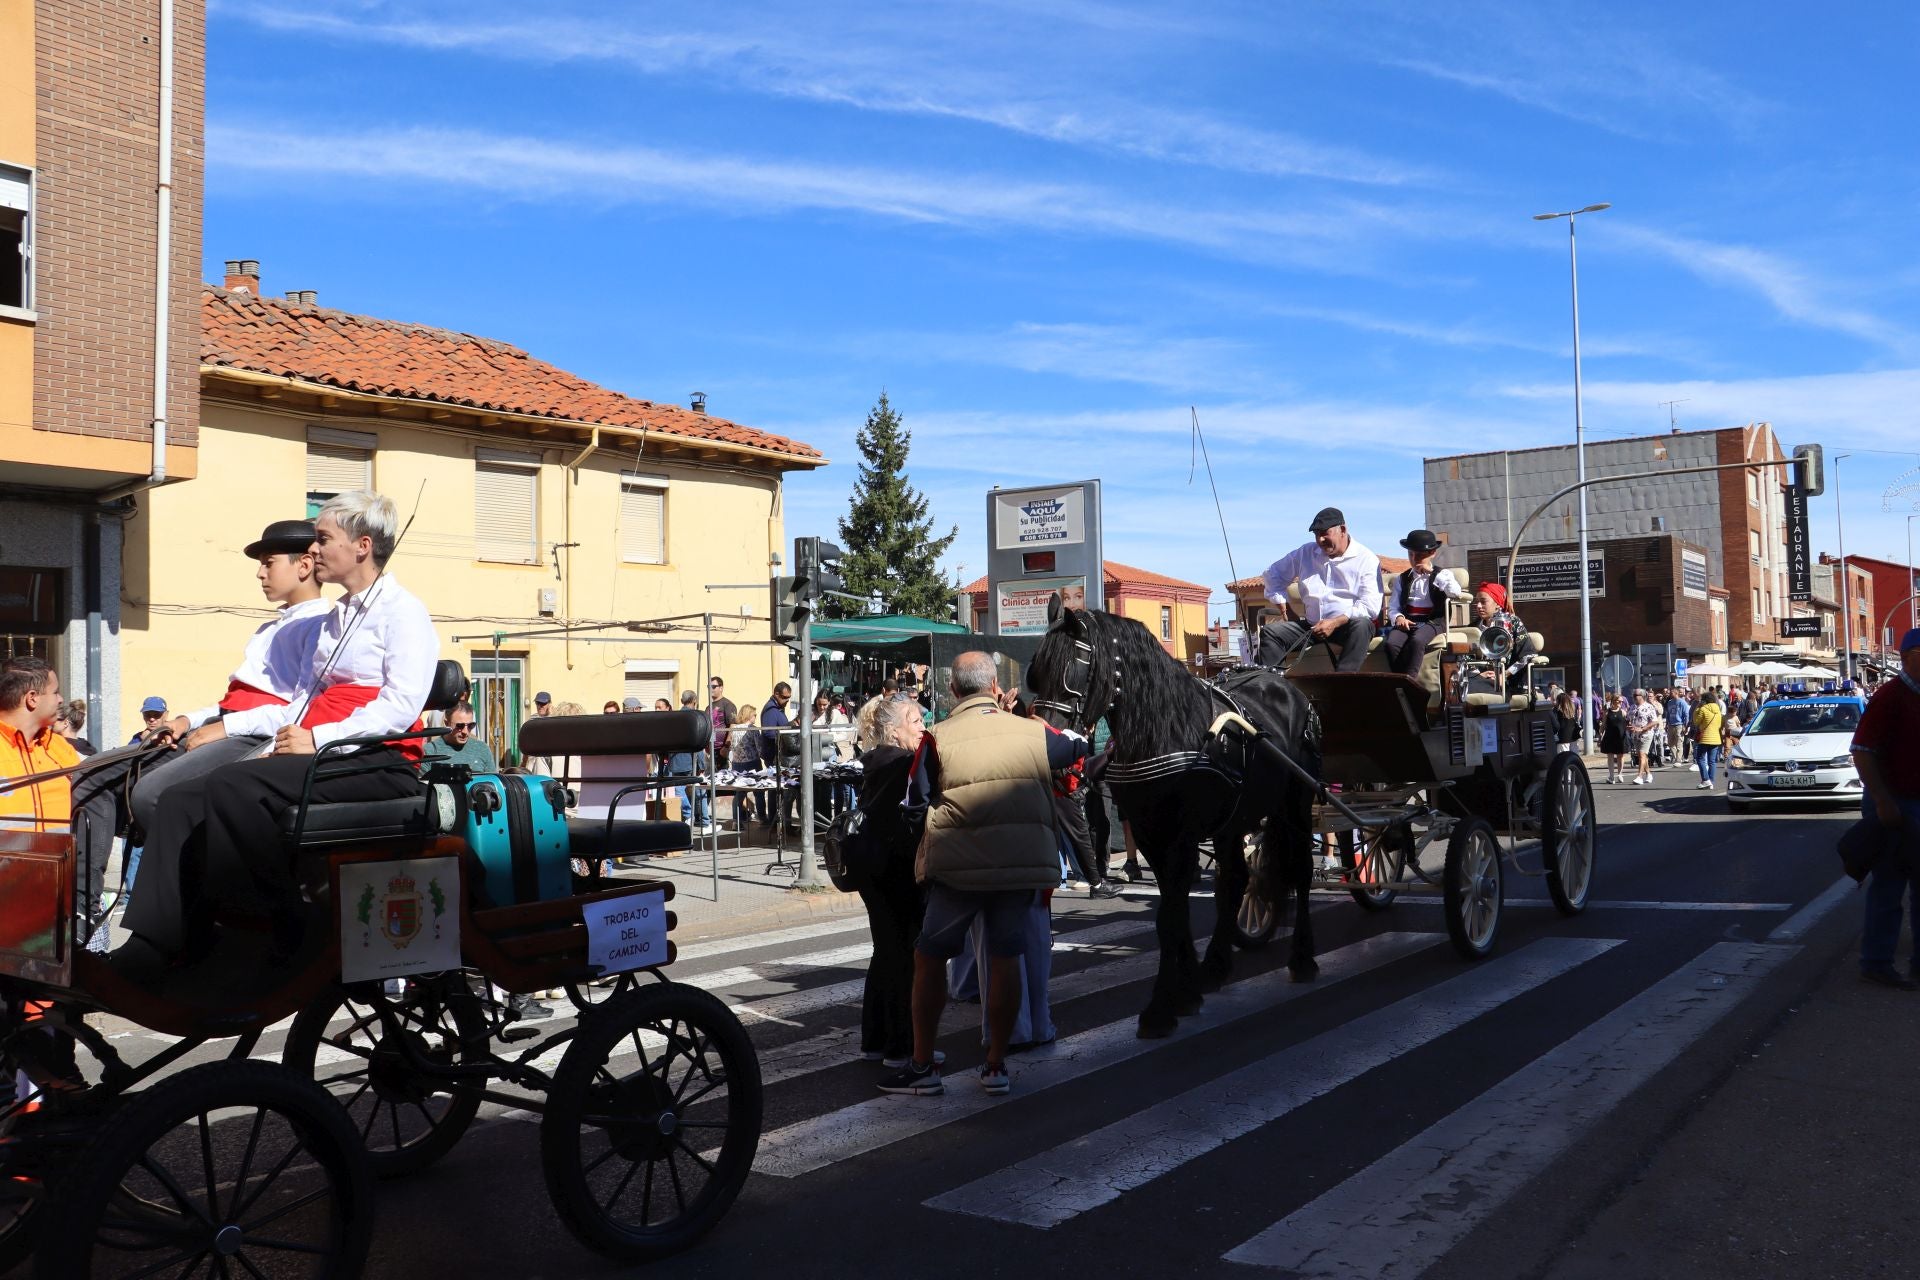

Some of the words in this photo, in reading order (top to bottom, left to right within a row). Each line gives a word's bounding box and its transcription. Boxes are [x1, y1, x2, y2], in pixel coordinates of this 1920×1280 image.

[1030, 514, 1066, 524] Publicidad
[1503, 566, 1544, 574] FRNÁNDEZ
[1774, 776, 1795, 785] 4345
[1797, 776, 1813, 785] KHT
[603, 907, 649, 926] TROBAJO
[621, 928, 639, 940] DEL
[608, 941, 650, 960] CAMINO
